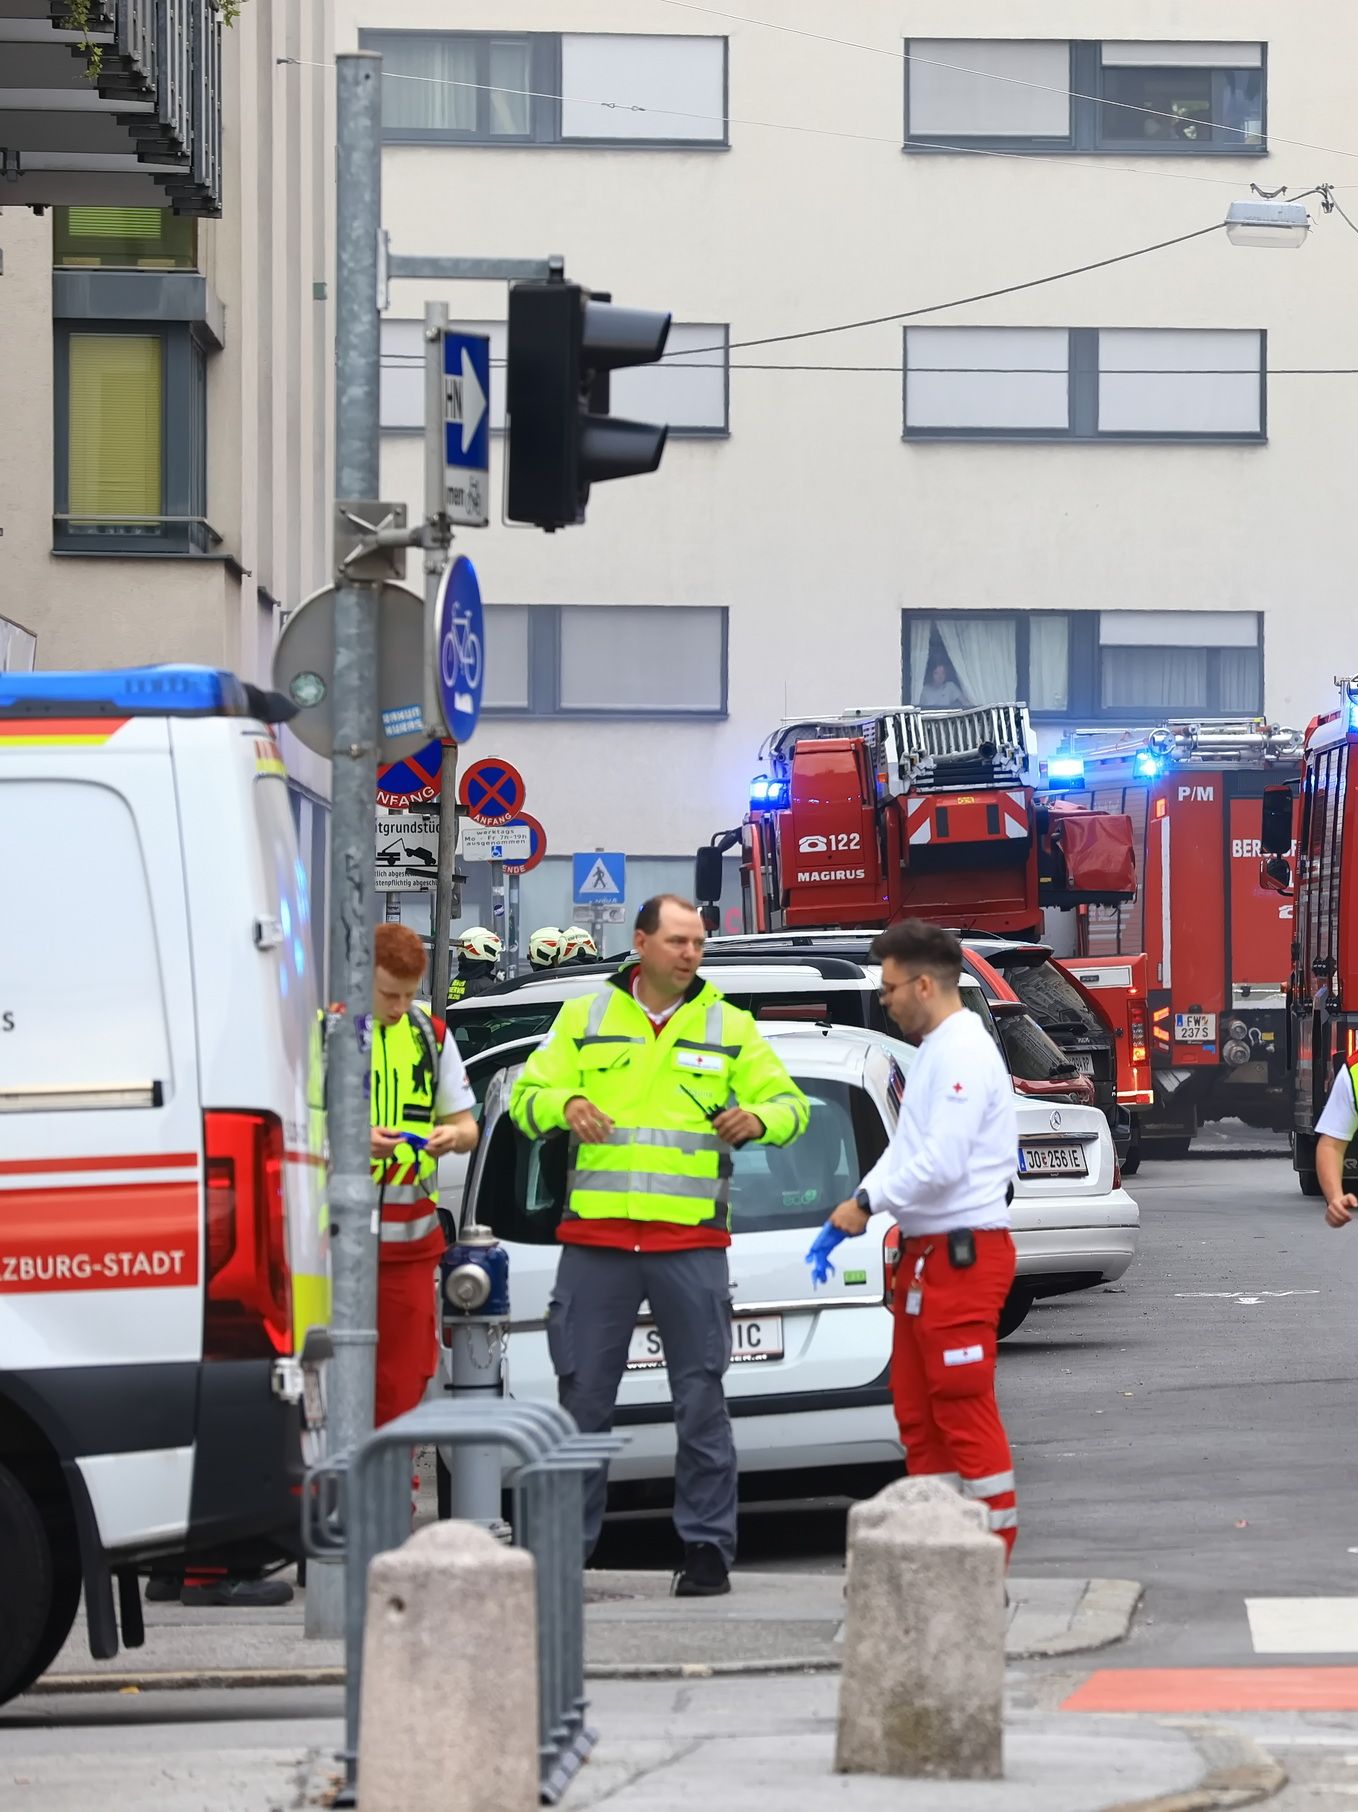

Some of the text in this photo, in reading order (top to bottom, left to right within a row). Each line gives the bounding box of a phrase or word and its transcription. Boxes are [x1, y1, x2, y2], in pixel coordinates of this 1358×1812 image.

[1178, 786, 1214, 801] P/M
[473, 813, 512, 825] ANFANG
[829, 832, 861, 851] 122
[502, 865, 526, 874] ENDE
[797, 869, 865, 882] MAGIRUS
[3, 1011, 15, 1032] S
[1187, 1016, 1201, 1027] FW
[1181, 1027, 1209, 1038] 237 S
[1048, 1151, 1068, 1168] 256
[0, 1250, 185, 1282] ZBURG-STADT
[646, 1323, 761, 1354] S IC
